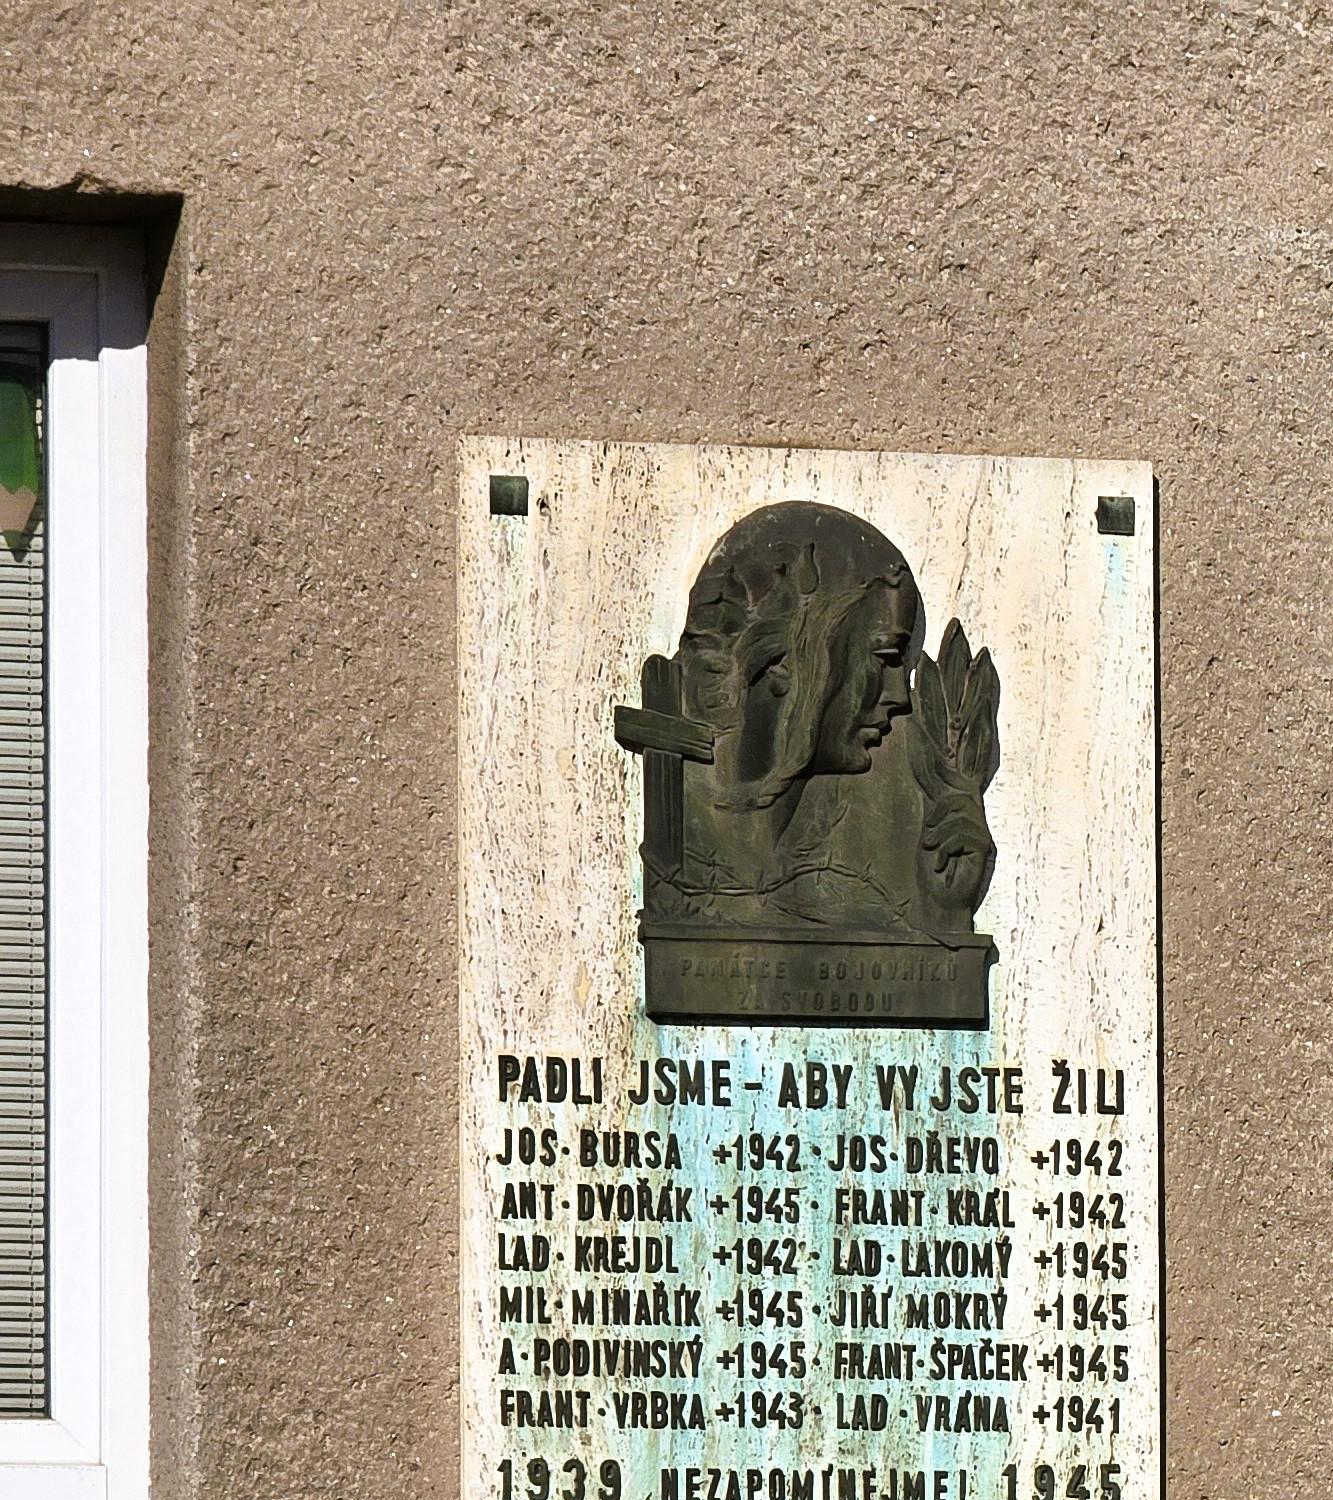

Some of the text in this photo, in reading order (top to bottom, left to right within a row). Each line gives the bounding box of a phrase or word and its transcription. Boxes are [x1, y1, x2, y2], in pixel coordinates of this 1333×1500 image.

[498, 1055, 603, 1105] PADLI
[628, 1057, 731, 1106] JSME
[777, 1062, 853, 1109] ABY
[876, 1065, 918, 1111] VY
[930, 1066, 1024, 1114] JSTE
[1052, 1059, 1124, 1115] ŽILI
[579, 1129, 682, 1170] BURSA
[906, 1131, 999, 1175] DŘEVO
[577, 1178, 692, 1223] DVOŘÁK
[948, 1188, 1015, 1228] KRÁL
[575, 1236, 679, 1274] KREJDL
[902, 1236, 1012, 1278] LAKOMÝ
[572, 1282, 701, 1326] MINAŘÍK
[830, 1284, 893, 1329] JIŘÍ
[906, 1287, 1007, 1330] MOKRÝ
[534, 1334, 703, 1378] PODIVINSKÝ
[929, 1337, 1028, 1381] ŠPAČEK
[613, 1392, 706, 1430] VRBKA
[916, 1391, 1009, 1433] VRÁNA
